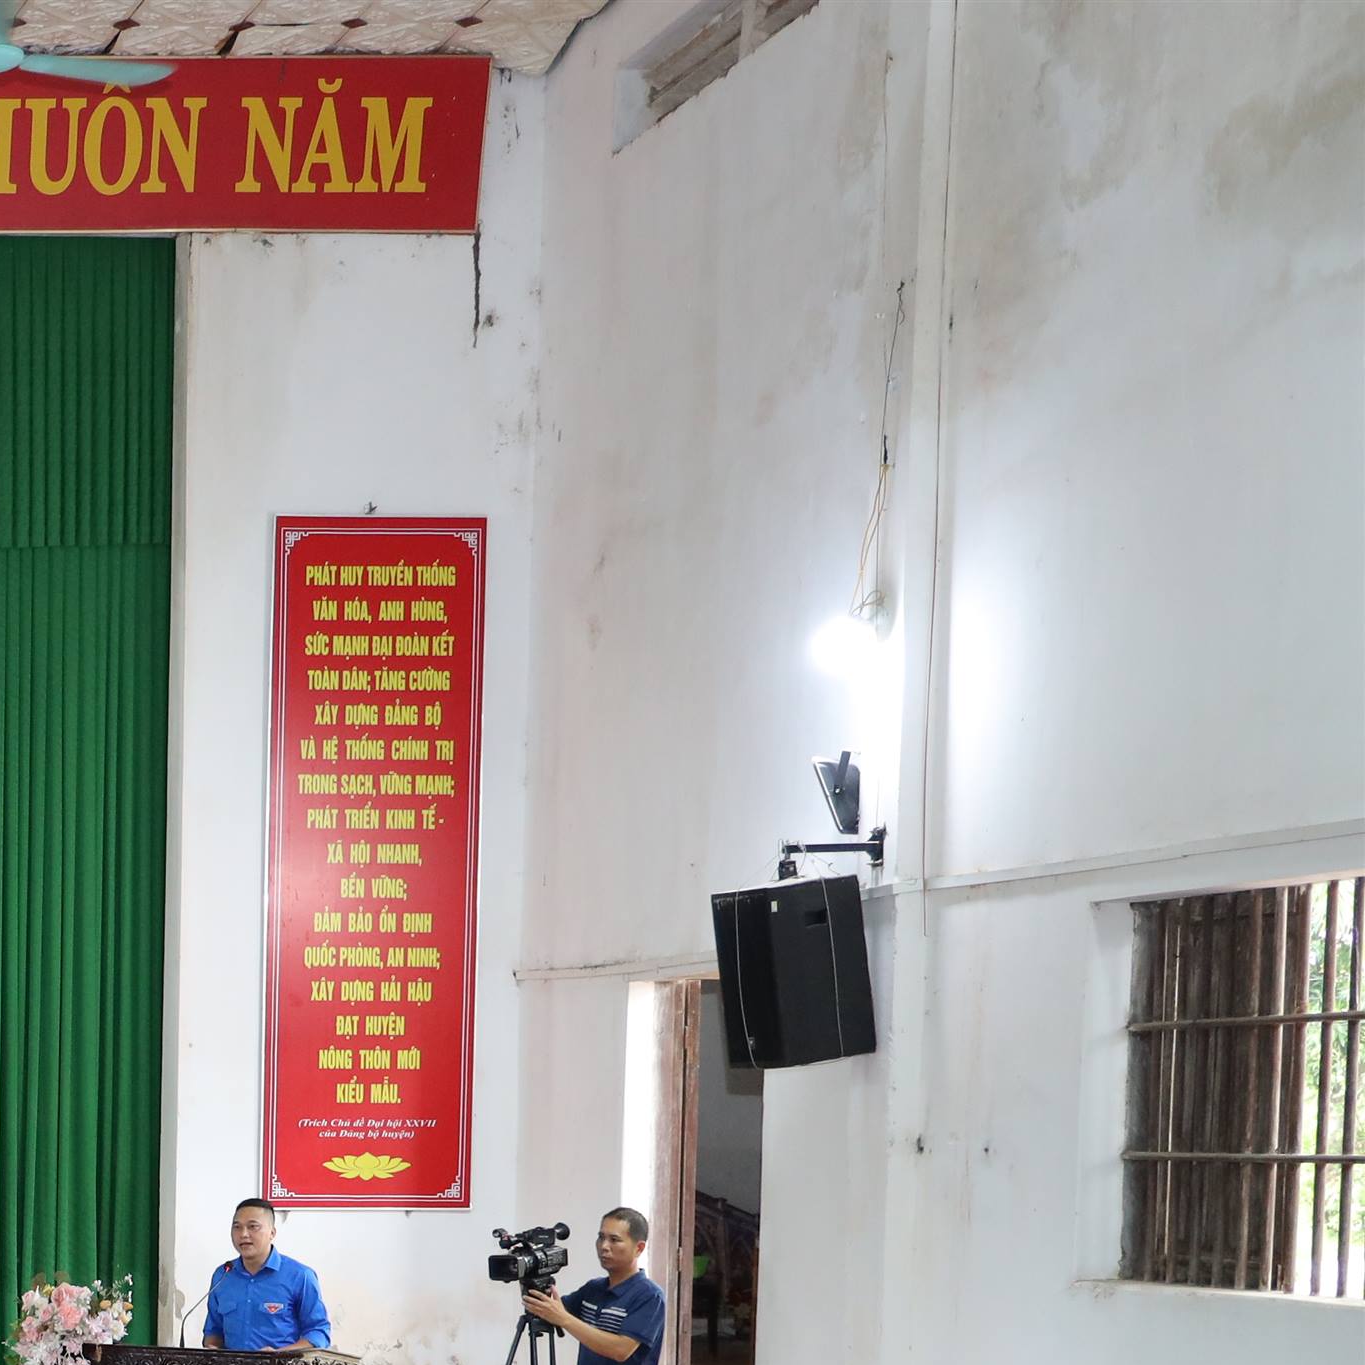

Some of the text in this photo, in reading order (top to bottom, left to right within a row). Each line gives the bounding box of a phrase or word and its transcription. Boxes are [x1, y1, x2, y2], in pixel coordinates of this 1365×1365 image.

[236, 77, 433, 195] NĂM
[306, 561, 337, 586] PHÁT
[340, 565, 364, 586] HUY
[416, 559, 456, 586] THỐNG
[312, 596, 448, 624] VĂN HÓA, ANH HÙNG,
[305, 630, 454, 661] SỨC MẠNH ĐẠI ĐOÀN KẾT
[307, 666, 450, 693] TOÀN DÂN; TĂNG CƯỜNG
[314, 698, 442, 730] XÂY DỰNG ĐẢNG BỘ
[311, 975, 432, 1006] XÂY DỰNG HẢI HẬU
[336, 1012, 405, 1040] ĐẠT HUYỆN
[319, 1045, 421, 1070] NÔNG THÔN MỚI
[336, 1076, 401, 1104] KIỂU MẪU.
